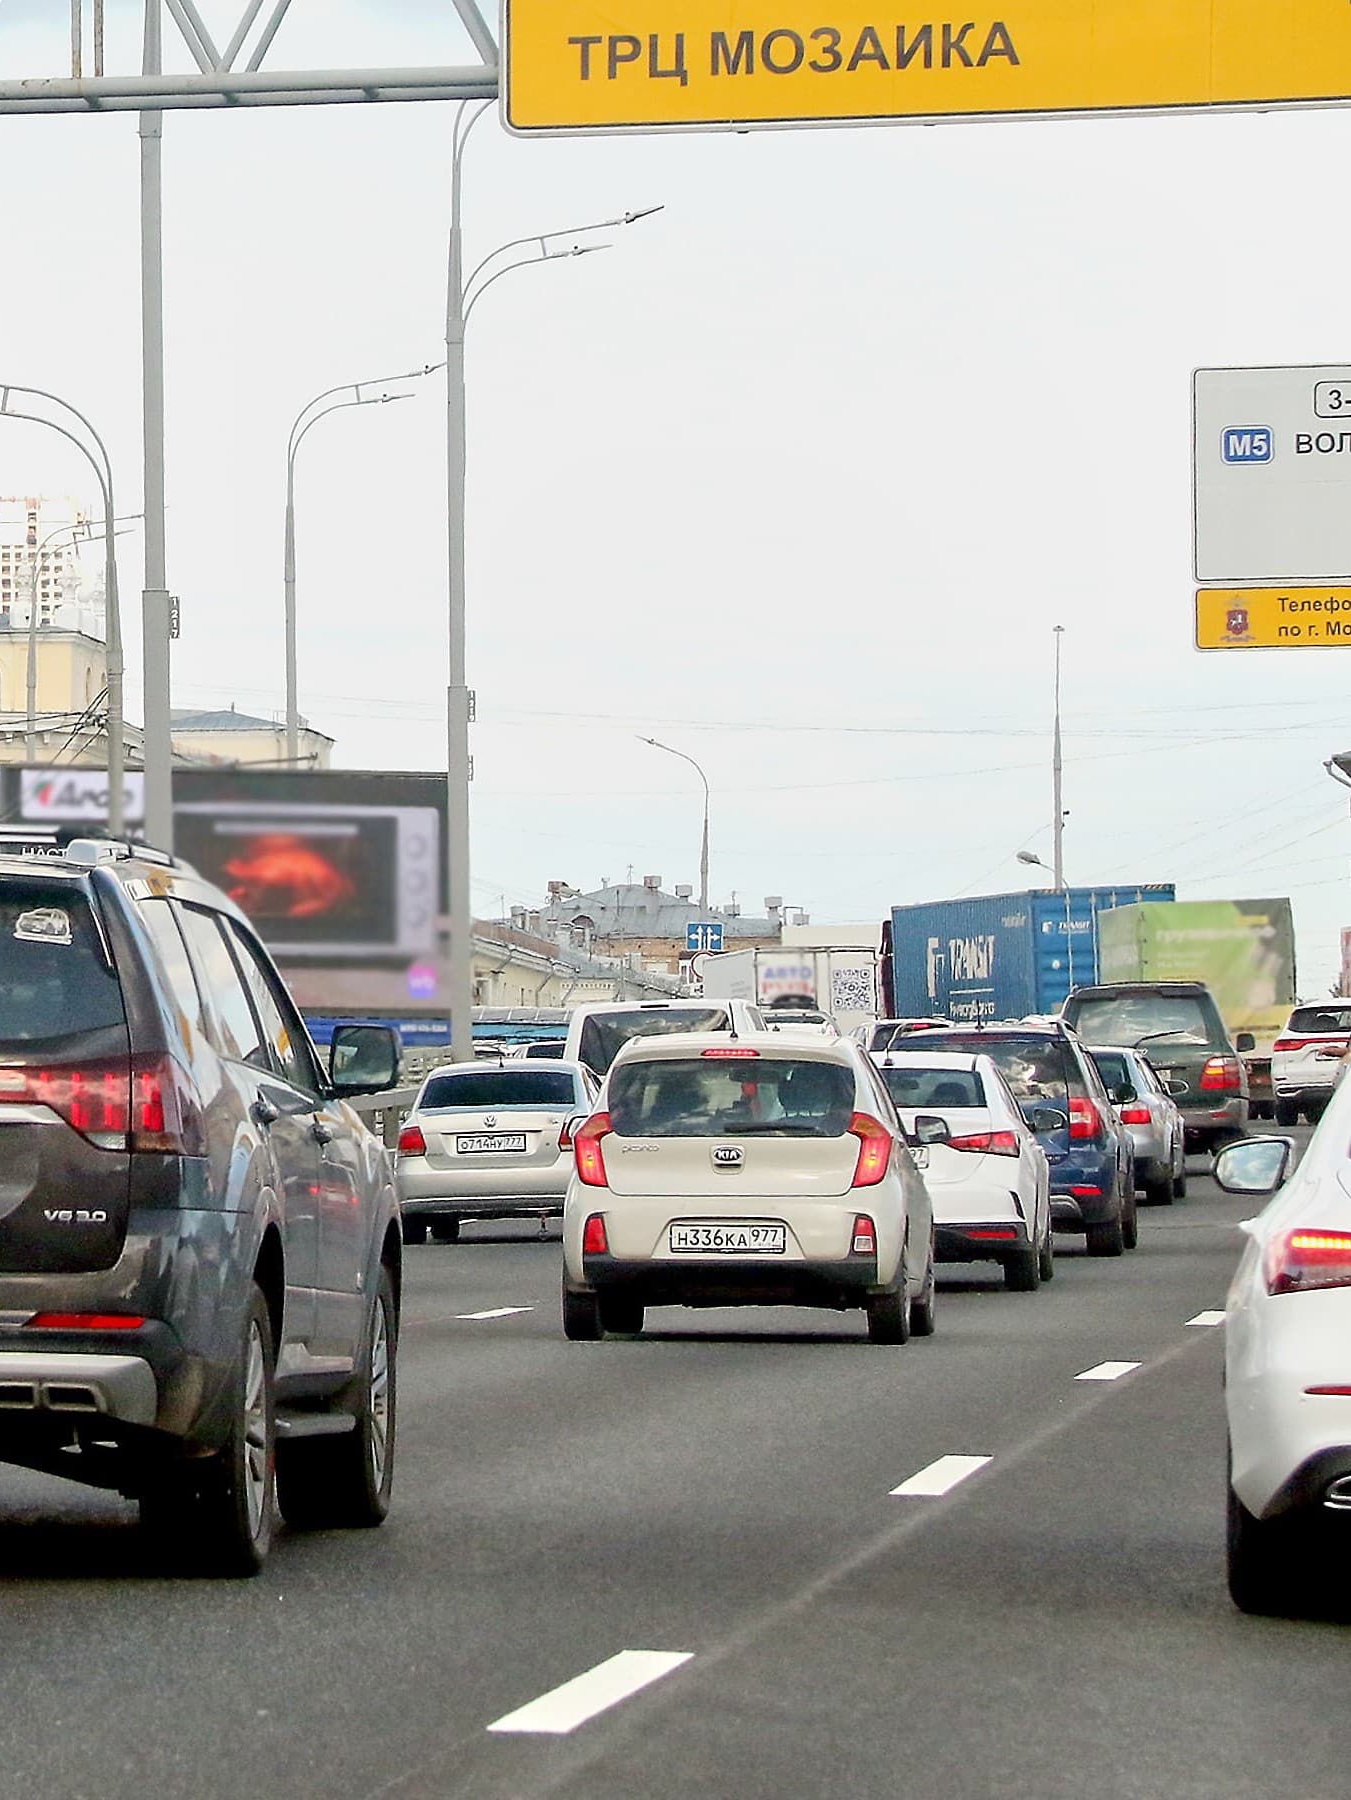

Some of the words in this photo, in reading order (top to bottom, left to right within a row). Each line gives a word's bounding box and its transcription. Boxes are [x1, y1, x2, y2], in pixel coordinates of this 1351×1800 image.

[567, 33, 688, 87] ТРЦ
[710, 20, 1021, 77] МОЗАИКА
[1278, 625, 1302, 637] по
[1308, 625, 1320, 636] г.
[717, 1148, 739, 1160] KIA
[677, 1228, 748, 1247] Н336КА
[751, 1228, 779, 1243] 977
